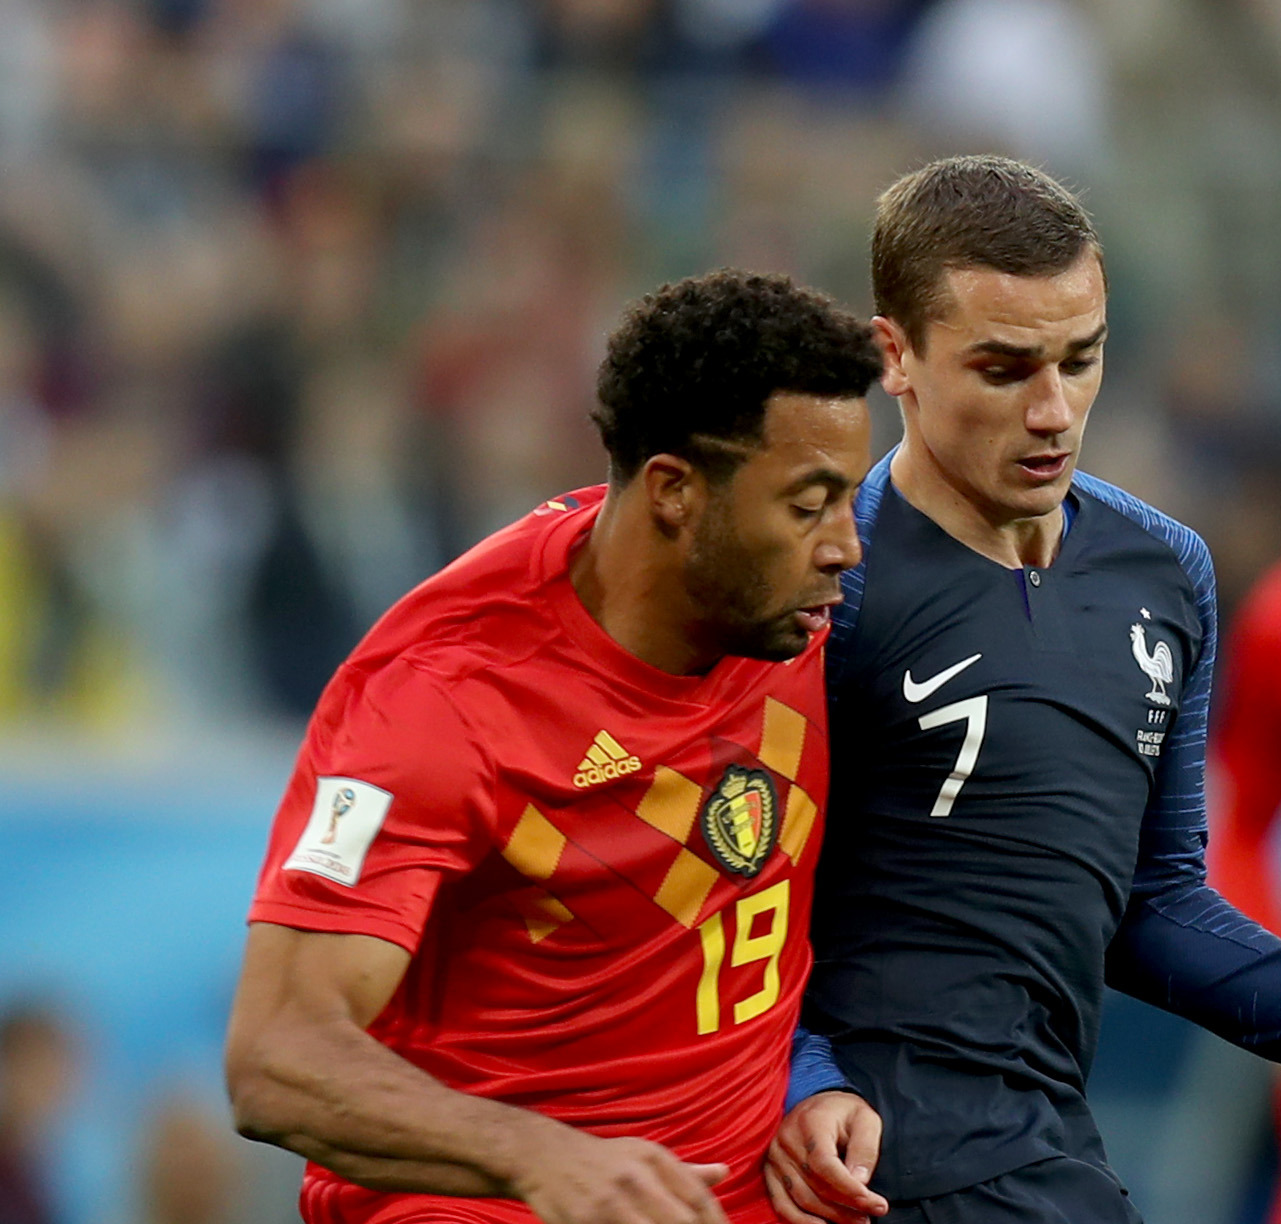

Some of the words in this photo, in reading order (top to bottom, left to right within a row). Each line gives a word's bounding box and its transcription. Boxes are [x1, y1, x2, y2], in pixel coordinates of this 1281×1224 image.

[572, 755, 642, 788] adidas
[918, 694, 988, 817] 7
[696, 879, 790, 1035] 19
